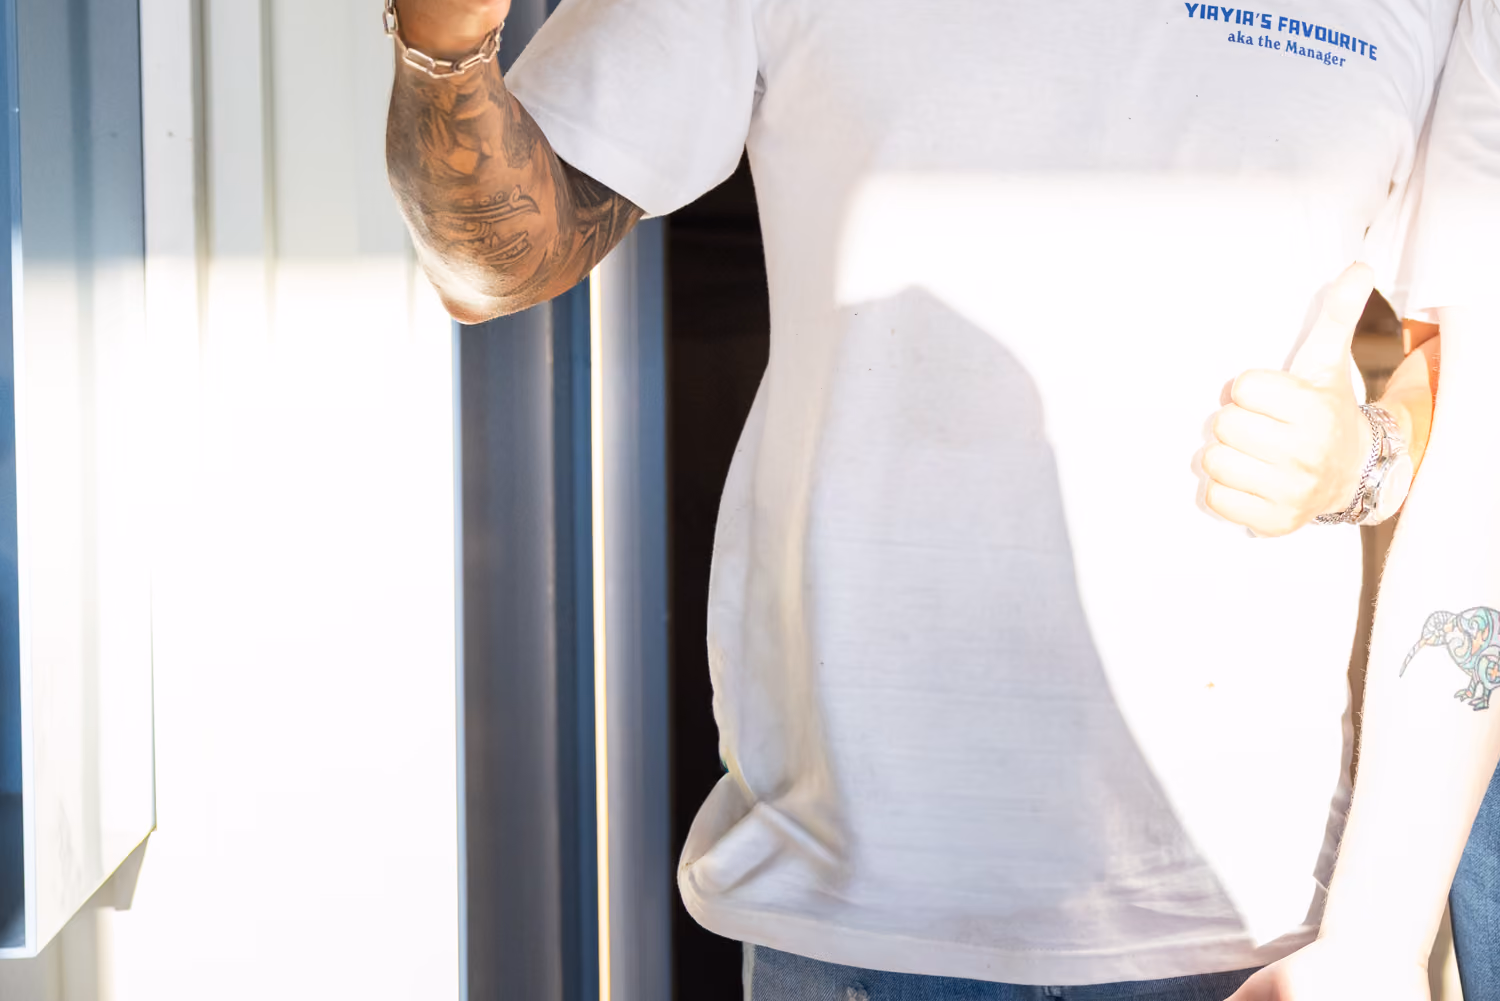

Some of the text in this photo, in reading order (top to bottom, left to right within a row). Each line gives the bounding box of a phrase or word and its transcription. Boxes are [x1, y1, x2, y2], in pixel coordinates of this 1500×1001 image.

[1184, 2, 1379, 62] YIAYIA'S FAVOURITE
[1227, 30, 1346, 67] aka the Manager
